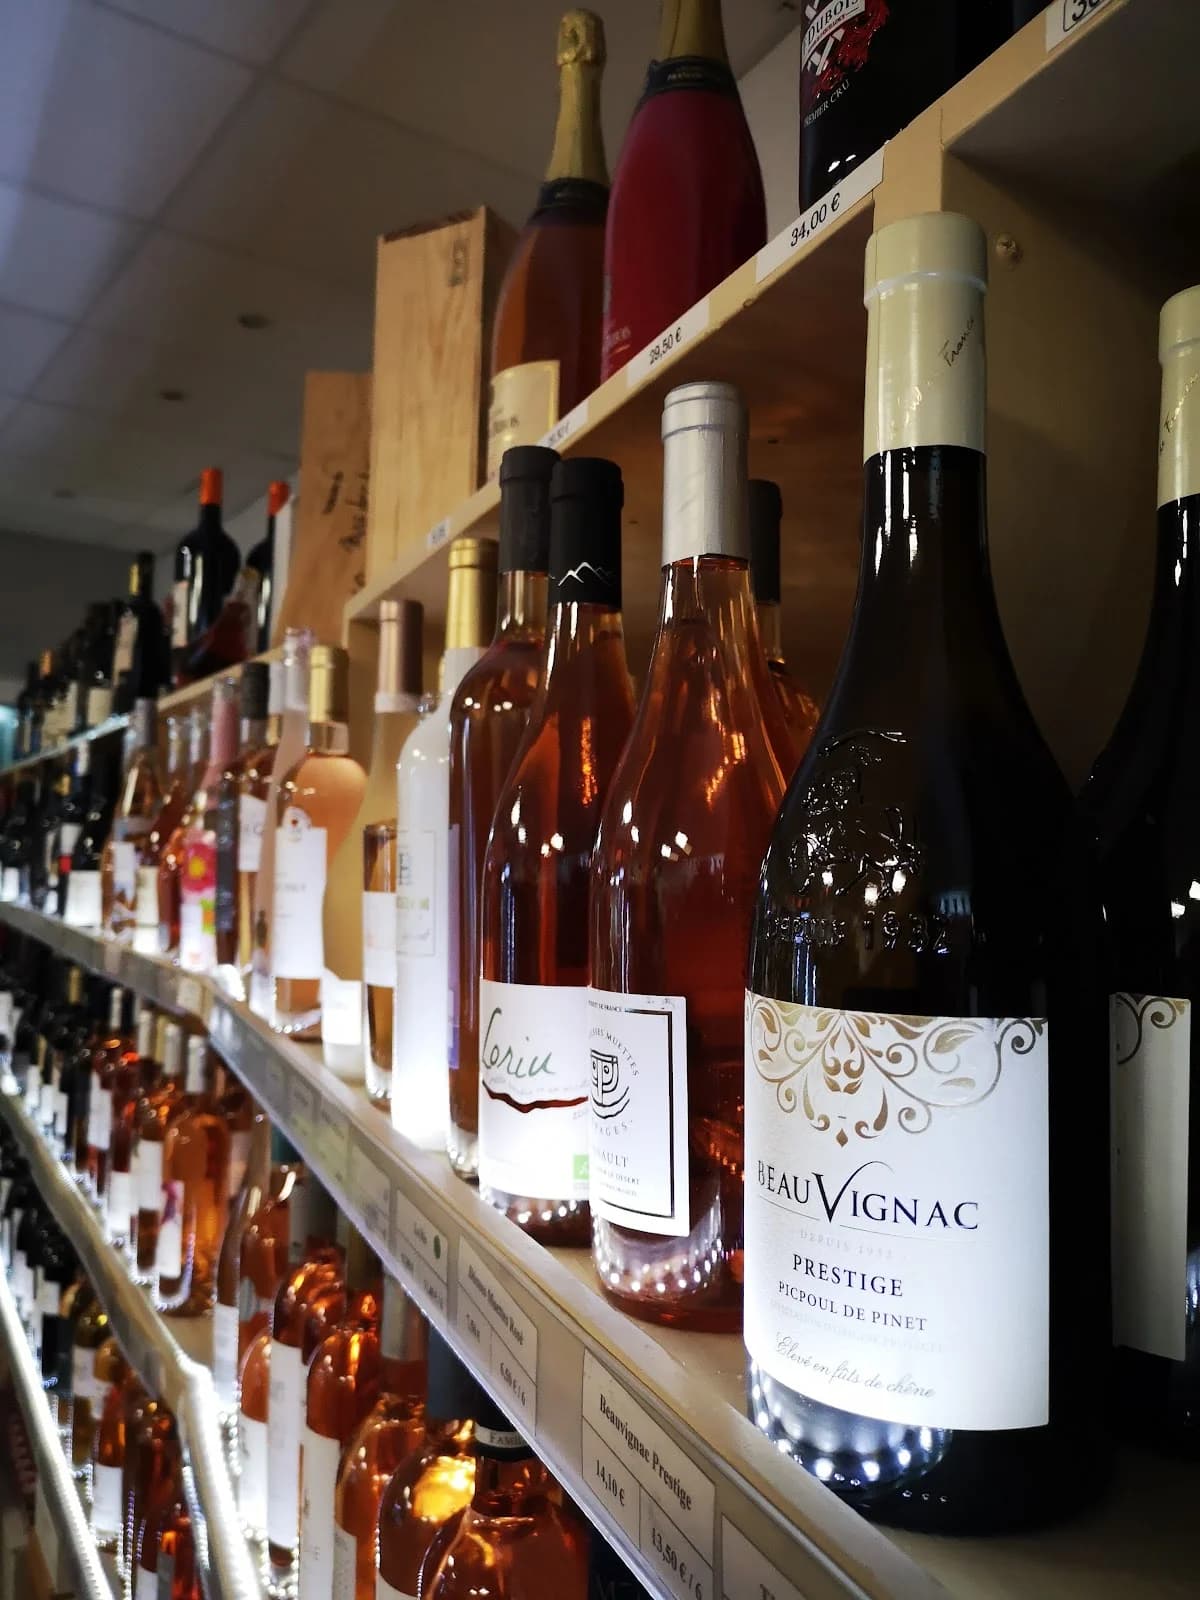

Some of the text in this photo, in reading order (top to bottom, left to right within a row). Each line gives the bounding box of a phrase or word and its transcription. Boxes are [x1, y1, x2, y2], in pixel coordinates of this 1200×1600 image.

[830, 79, 849, 103] CRU
[790, 192, 840, 247] 34,00 €
[650, 334, 674, 366] 29,50
[676, 327, 682, 343] €
[758, 1160, 978, 1230] BEAUVIGNAC
[792, 1253, 903, 1297] PRESTIGE
[778, 1280, 927, 1331] PICPOUL DE PINET
[813, 1362, 831, 1376] en
[864, 1373, 882, 1389] de
[886, 1373, 936, 1398] chêne
[600, 1392, 692, 1511] Beauvignac Prestige
[596, 1459, 625, 1508] 14,10 €
[652, 1527, 677, 1571] 13,50
[679, 1562, 687, 1584] €
[688, 1573, 694, 1590] /
